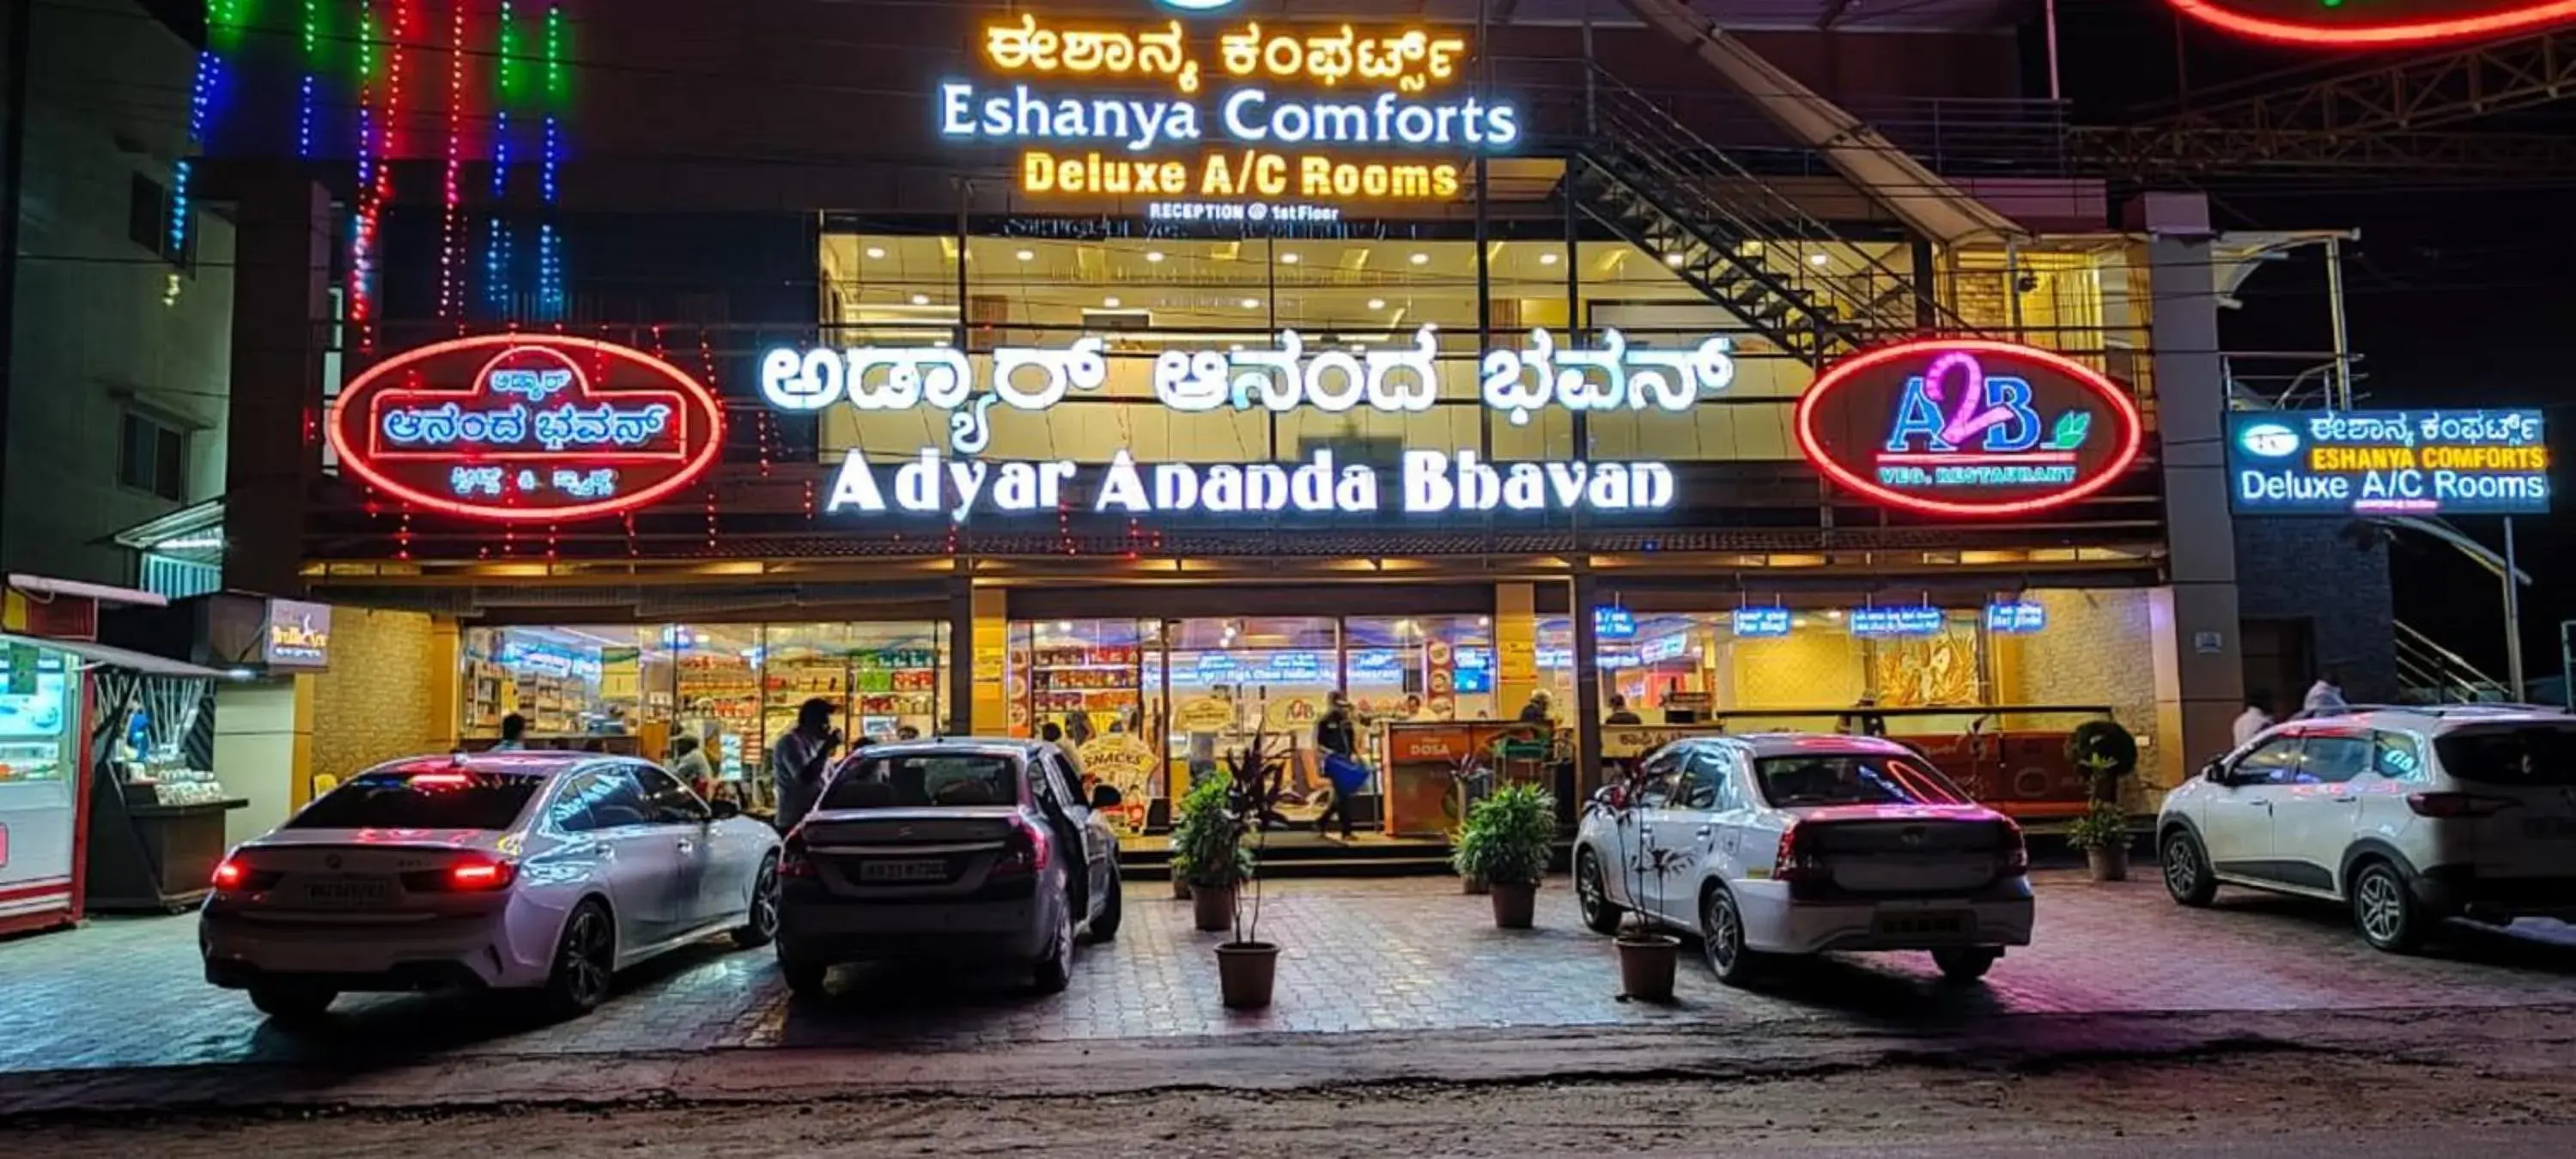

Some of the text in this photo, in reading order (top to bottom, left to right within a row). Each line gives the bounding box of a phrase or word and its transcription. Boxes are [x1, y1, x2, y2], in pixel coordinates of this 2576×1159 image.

[987, 15, 1199, 91] ಈಶಾನ್ಯ
[943, 83, 1516, 149] Eshanya Comforts
[1024, 150, 1458, 197] Deluxe A/C Rooms
[1150, 202, 1244, 220] RECEPTION
[1153, 324, 1438, 410] ಆನಂದ
[1483, 325, 1736, 424] ಭವನ್
[1886, 351, 2040, 452] A2B
[383, 402, 670, 450] ಆನಂದ ಭವನ್
[2310, 410, 2415, 446] ಈಶಾನ್ಯ
[1879, 466, 2077, 485] VEG. RESTAURANT
[2312, 446, 2544, 469] ESHANYA COMFORTS
[827, 449, 1676, 520] Adyar Ananda Bhavan
[2242, 470, 2544, 500] Deluxe A/C Rooms
[1082, 752, 1141, 768] SNACKS
[1409, 743, 1450, 755] DOSA
